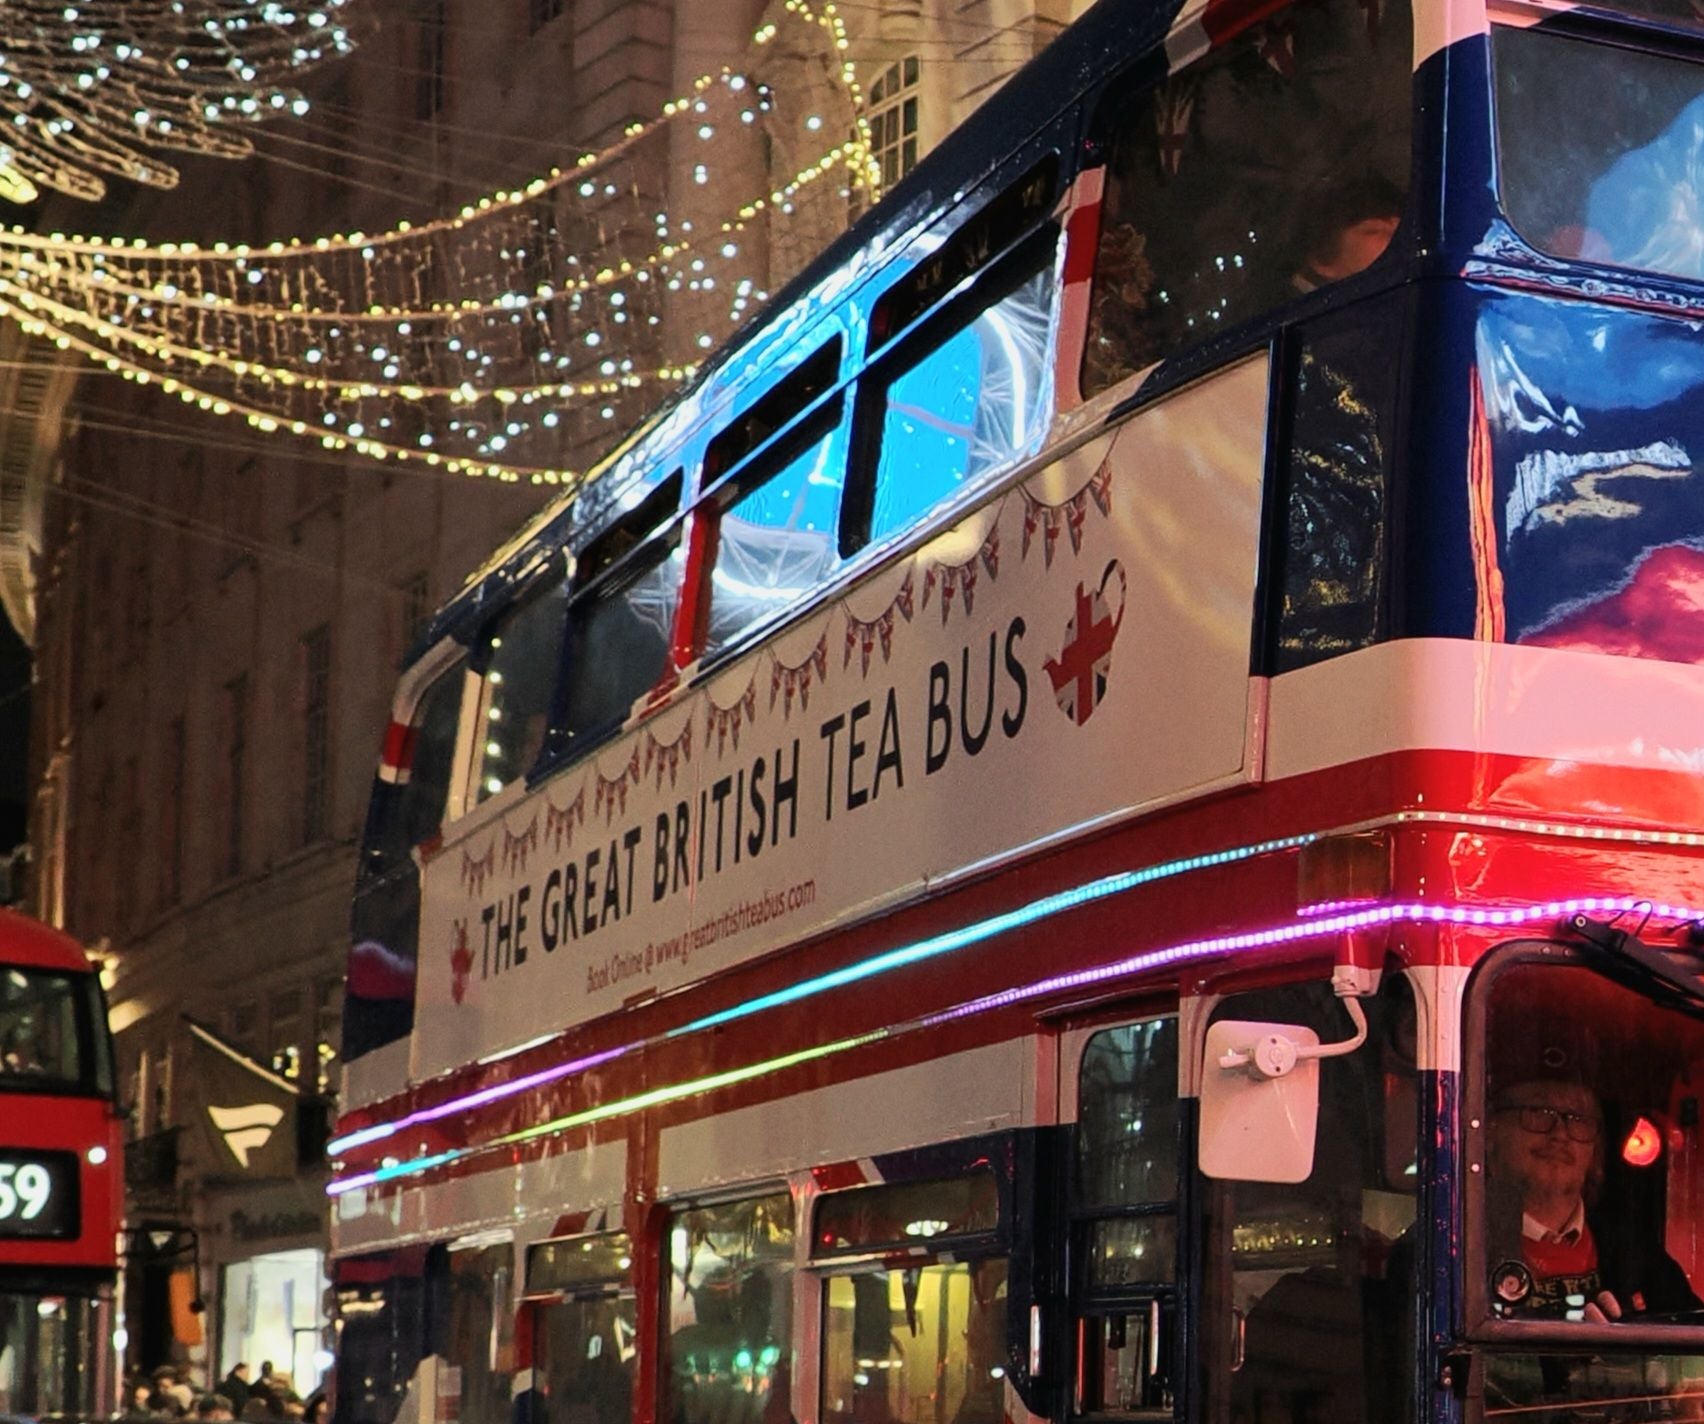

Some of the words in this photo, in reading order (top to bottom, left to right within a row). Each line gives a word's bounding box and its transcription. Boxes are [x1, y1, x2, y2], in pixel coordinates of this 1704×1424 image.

[481, 884, 532, 981] THE
[541, 825, 642, 952] GREAT
[652, 738, 800, 903] BRITISH
[819, 685, 904, 822] TEA
[926, 615, 1028, 776] BUS
[0, 1162, 51, 1220] 59
